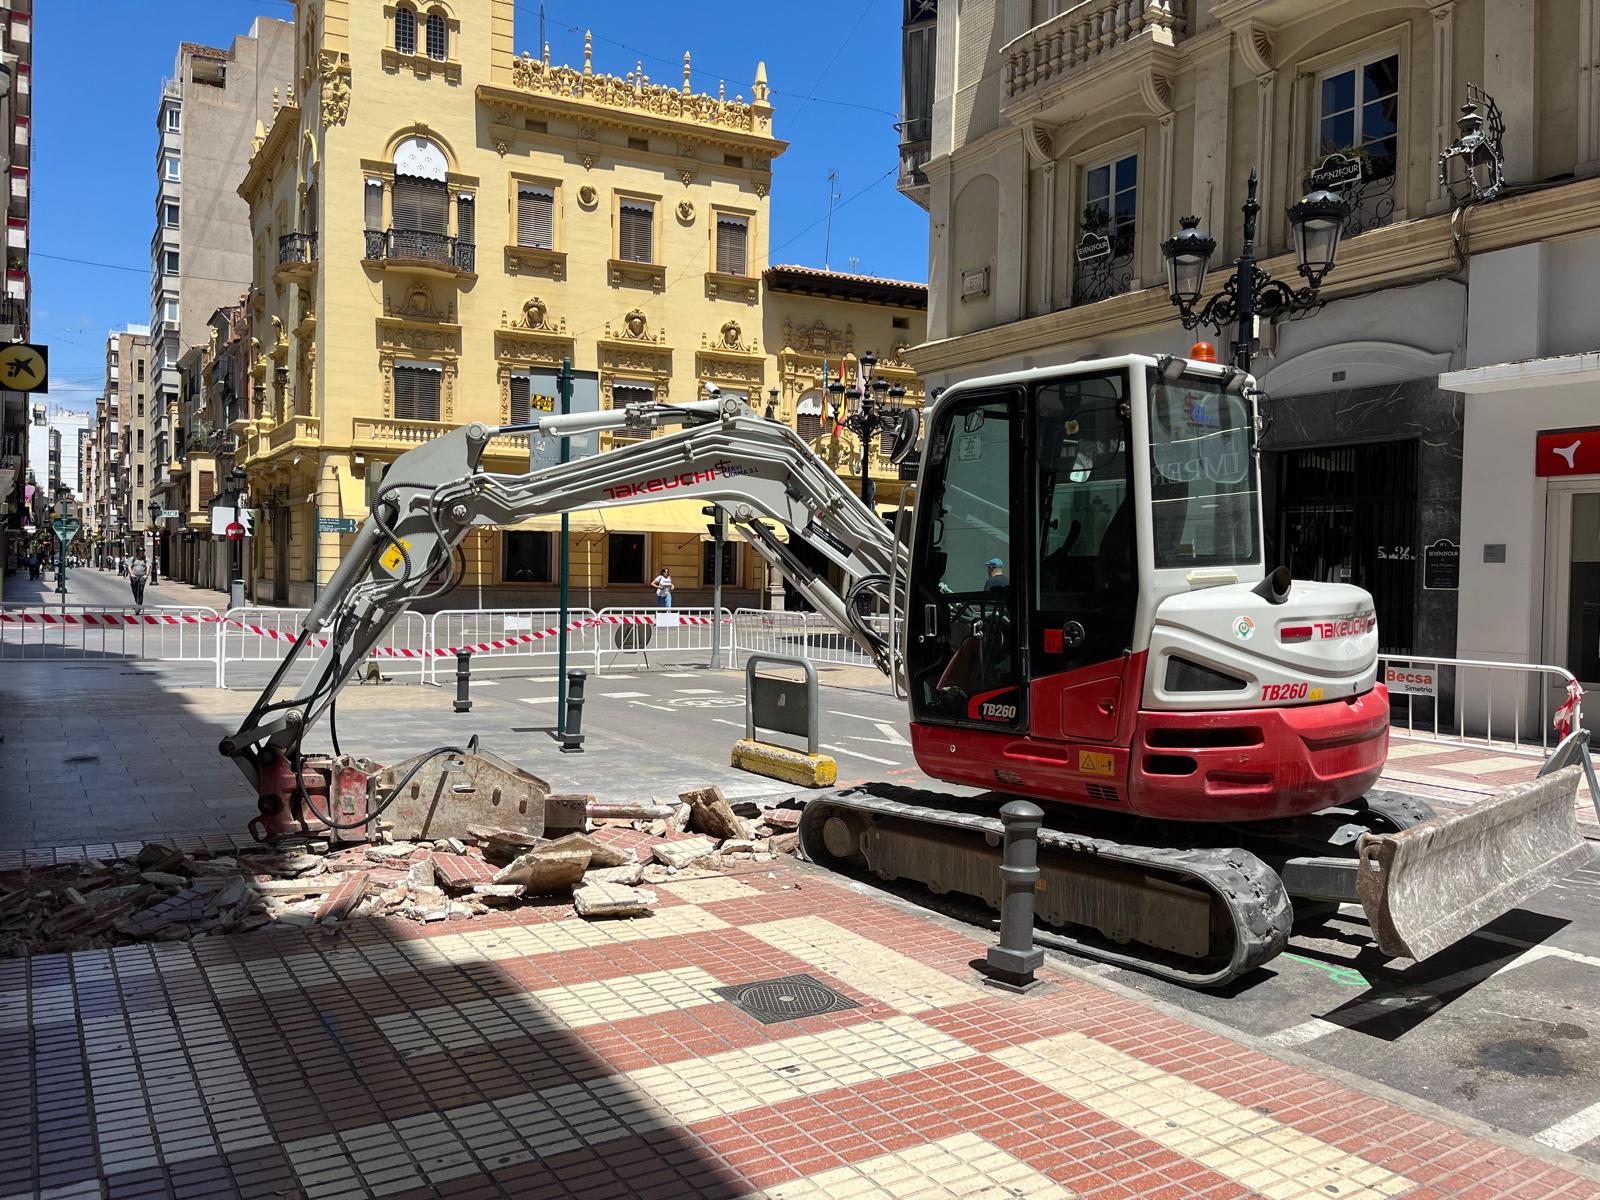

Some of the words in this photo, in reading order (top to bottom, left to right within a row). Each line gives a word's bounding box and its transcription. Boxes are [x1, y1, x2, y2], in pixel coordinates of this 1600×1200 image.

[1386, 669, 1433, 685] Becsa
[1261, 683, 1309, 702] TB260
[982, 702, 1017, 719] TB260
